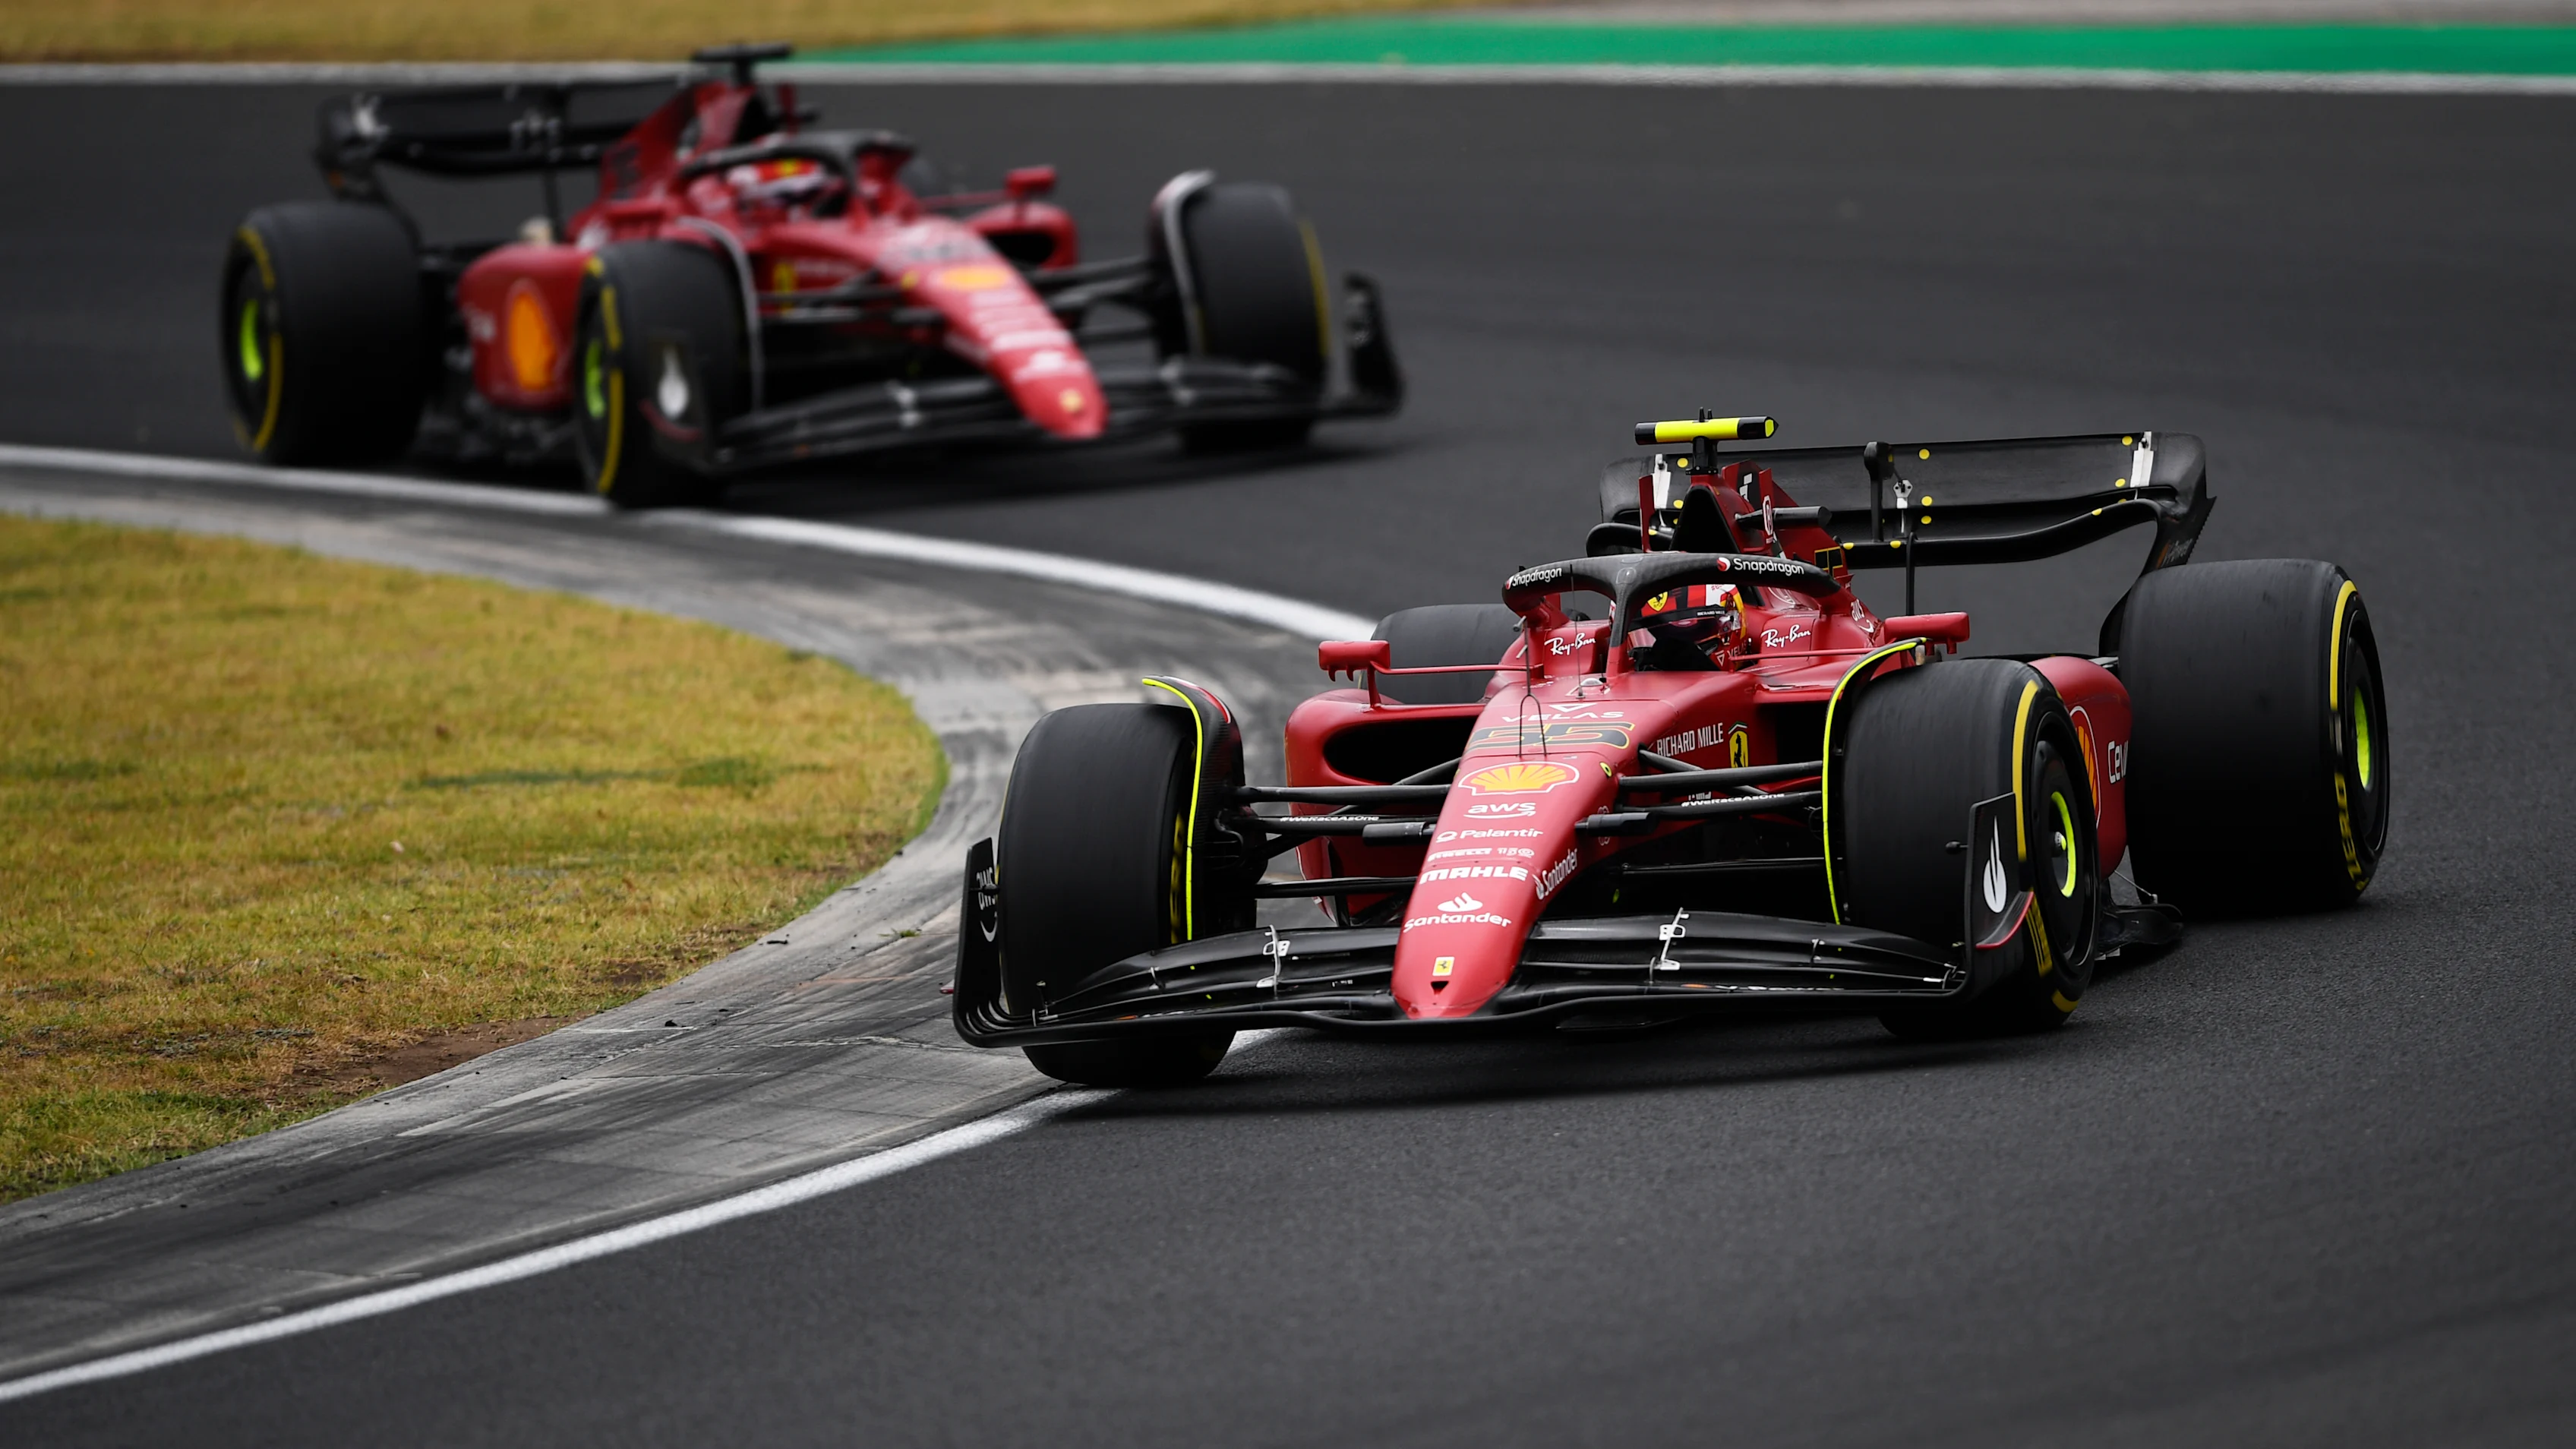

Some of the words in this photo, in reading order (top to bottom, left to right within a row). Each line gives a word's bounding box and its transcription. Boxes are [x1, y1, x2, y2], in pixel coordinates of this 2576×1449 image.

[1512, 567, 1563, 587] Snapdragon
[1733, 558, 1805, 576] Snapdragon
[1544, 632, 1596, 656] Ray-Ban
[1760, 624, 1811, 648] Ray-Ban
[1502, 711, 1625, 723] VELAS
[1466, 721, 1636, 755] 55
[1656, 730, 1696, 758] RICHARD
[1697, 722, 1725, 750] MILLE
[1467, 802, 1537, 814] aws
[1681, 793, 1785, 807] #WeRaceAsOne
[1460, 828, 1544, 839] Palantir
[1419, 866, 1529, 885] MAHLE
[1542, 848, 1578, 896] Santander
[1403, 912, 1512, 933] Santander
